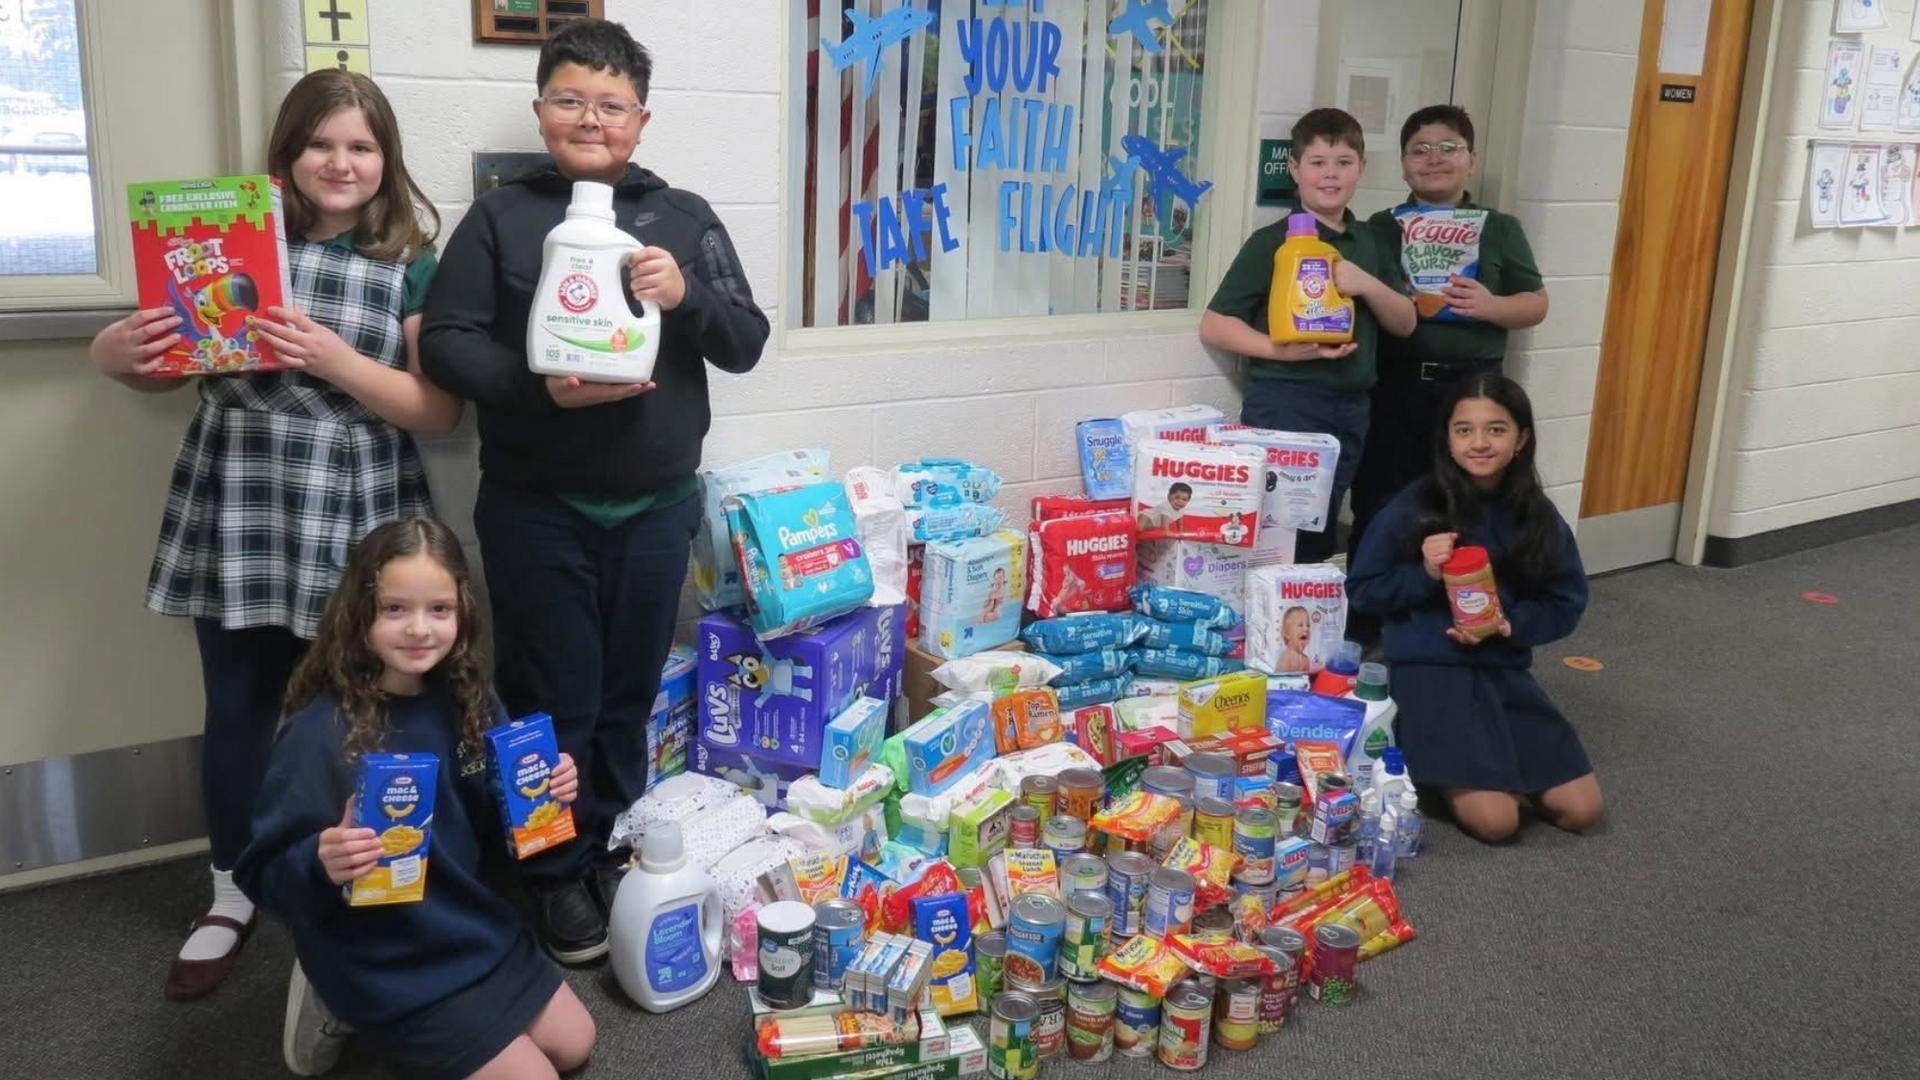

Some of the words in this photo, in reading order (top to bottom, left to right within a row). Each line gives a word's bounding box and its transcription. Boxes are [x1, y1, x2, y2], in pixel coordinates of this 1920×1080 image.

[957, 16, 1062, 96] YOUR
[1663, 87, 1693, 100] WOMEN
[949, 96, 1074, 173] FAITH
[1271, 147, 1292, 159] MAI
[1264, 162, 1290, 175] OFFI
[852, 182, 960, 278] TAKE
[1000, 181, 1134, 258] FLIGHT
[1395, 217, 1478, 244] Veggie
[164, 238, 223, 271] FROOT
[1404, 244, 1465, 262] FLAVOR
[173, 256, 229, 284] LOOPS
[1409, 257, 1457, 274] BURST
[546, 314, 591, 325] sensitive
[593, 318, 613, 328] skin
[546, 349, 560, 358] 105
[1087, 435, 1122, 447] Snuggle
[1265, 447, 1319, 468] GGIES
[1152, 457, 1249, 483] HUGGIES
[778, 522, 839, 550] Pampers
[1066, 534, 1129, 557] HUGGIES
[1208, 561, 1247, 572] Diapers
[1281, 582, 1343, 599] HUGGIES
[1082, 629, 1113, 640] Sensitive
[1214, 691, 1250, 709] Cheerios
[1272, 724, 1341, 739] avender
[516, 763, 539, 777] mac
[539, 759, 547, 769] &
[386, 787, 409, 795] mac
[409, 785, 417, 794] &
[653, 917, 693, 937] Lavender
[654, 930, 683, 945] Bloom
